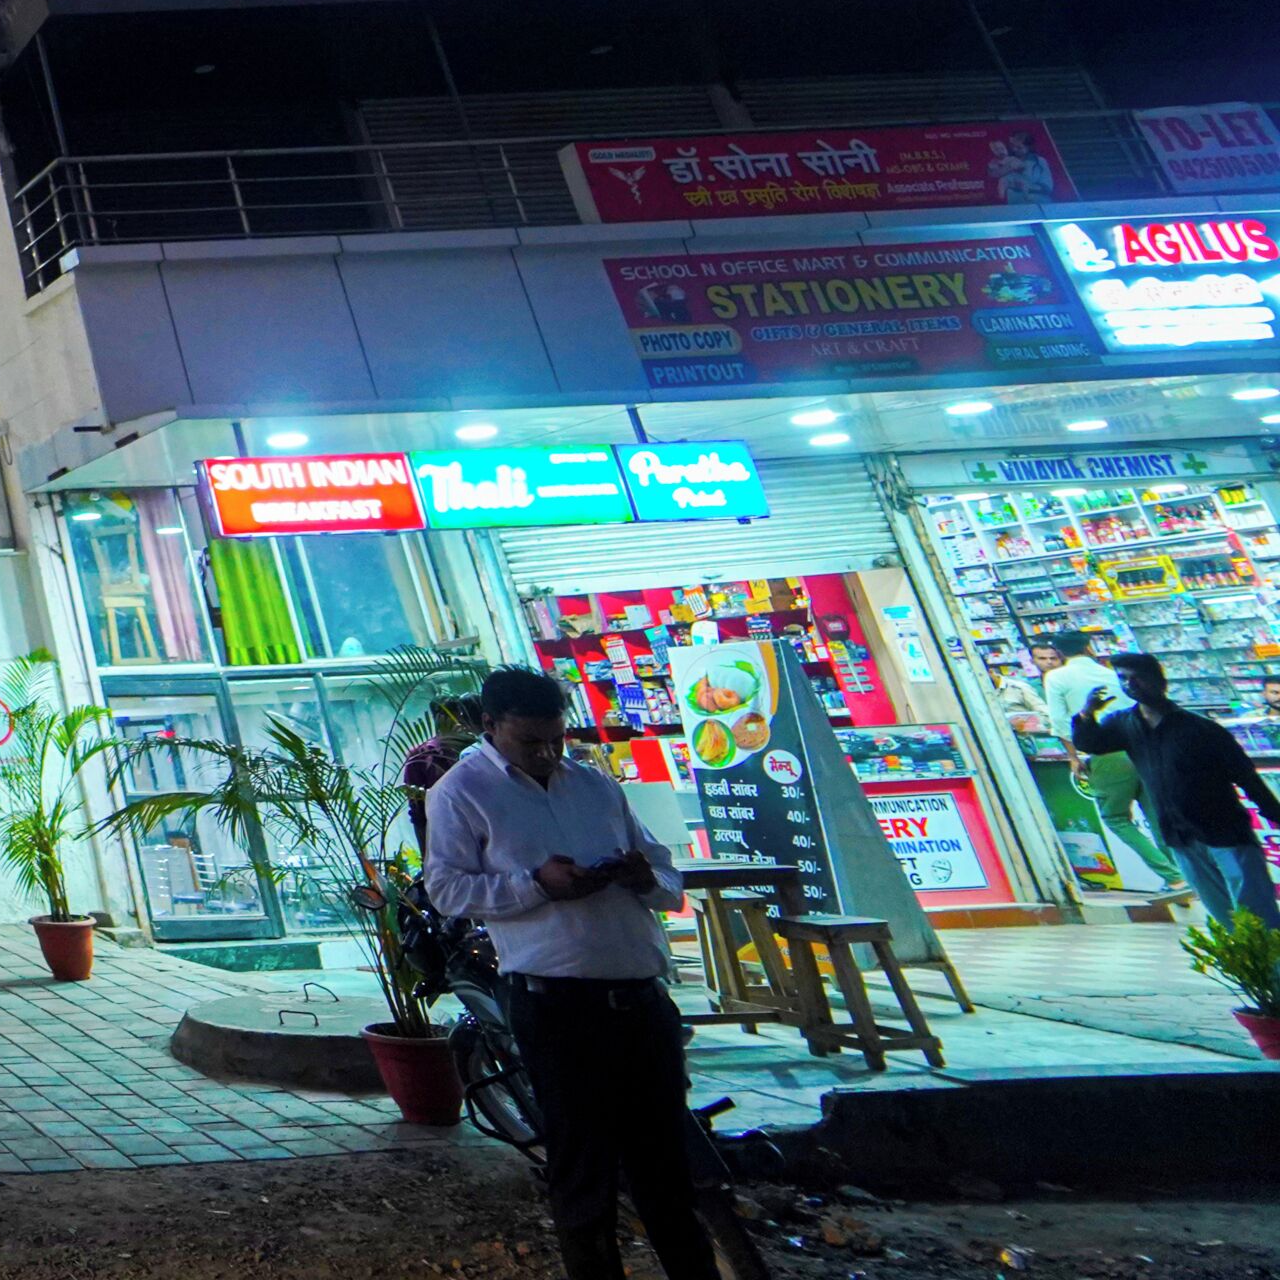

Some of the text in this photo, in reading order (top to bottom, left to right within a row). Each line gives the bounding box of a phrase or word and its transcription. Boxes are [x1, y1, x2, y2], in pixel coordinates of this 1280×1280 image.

[796, 139, 881, 178] सोनी
[1116, 219, 1280, 264] AGILUS
[620, 245, 1032, 280] SCHOOL N OFFICE MART & COMMUNICATION
[706, 272, 969, 320] STATIONERY
[751, 324, 804, 342] GIFTS
[822, 319, 905, 340] GENERAL
[979, 312, 1074, 333] LAMINATION
[640, 329, 733, 353] PHOTO COPY
[863, 337, 921, 354] CRAFT
[996, 343, 1089, 361] SPIRAL BINDING
[651, 363, 745, 385] PRINTOUT
[208, 459, 408, 490] SOUTH INDIAN
[998, 453, 1177, 482] VINAYAK CHEMIST
[251, 499, 382, 523] BREAKFAST
[781, 786, 805, 800] 30/-
[787, 810, 811, 824] 40/-
[792, 835, 816, 849] 40/-
[797, 860, 822, 874] 50/-
[803, 885, 828, 899] 50/-
